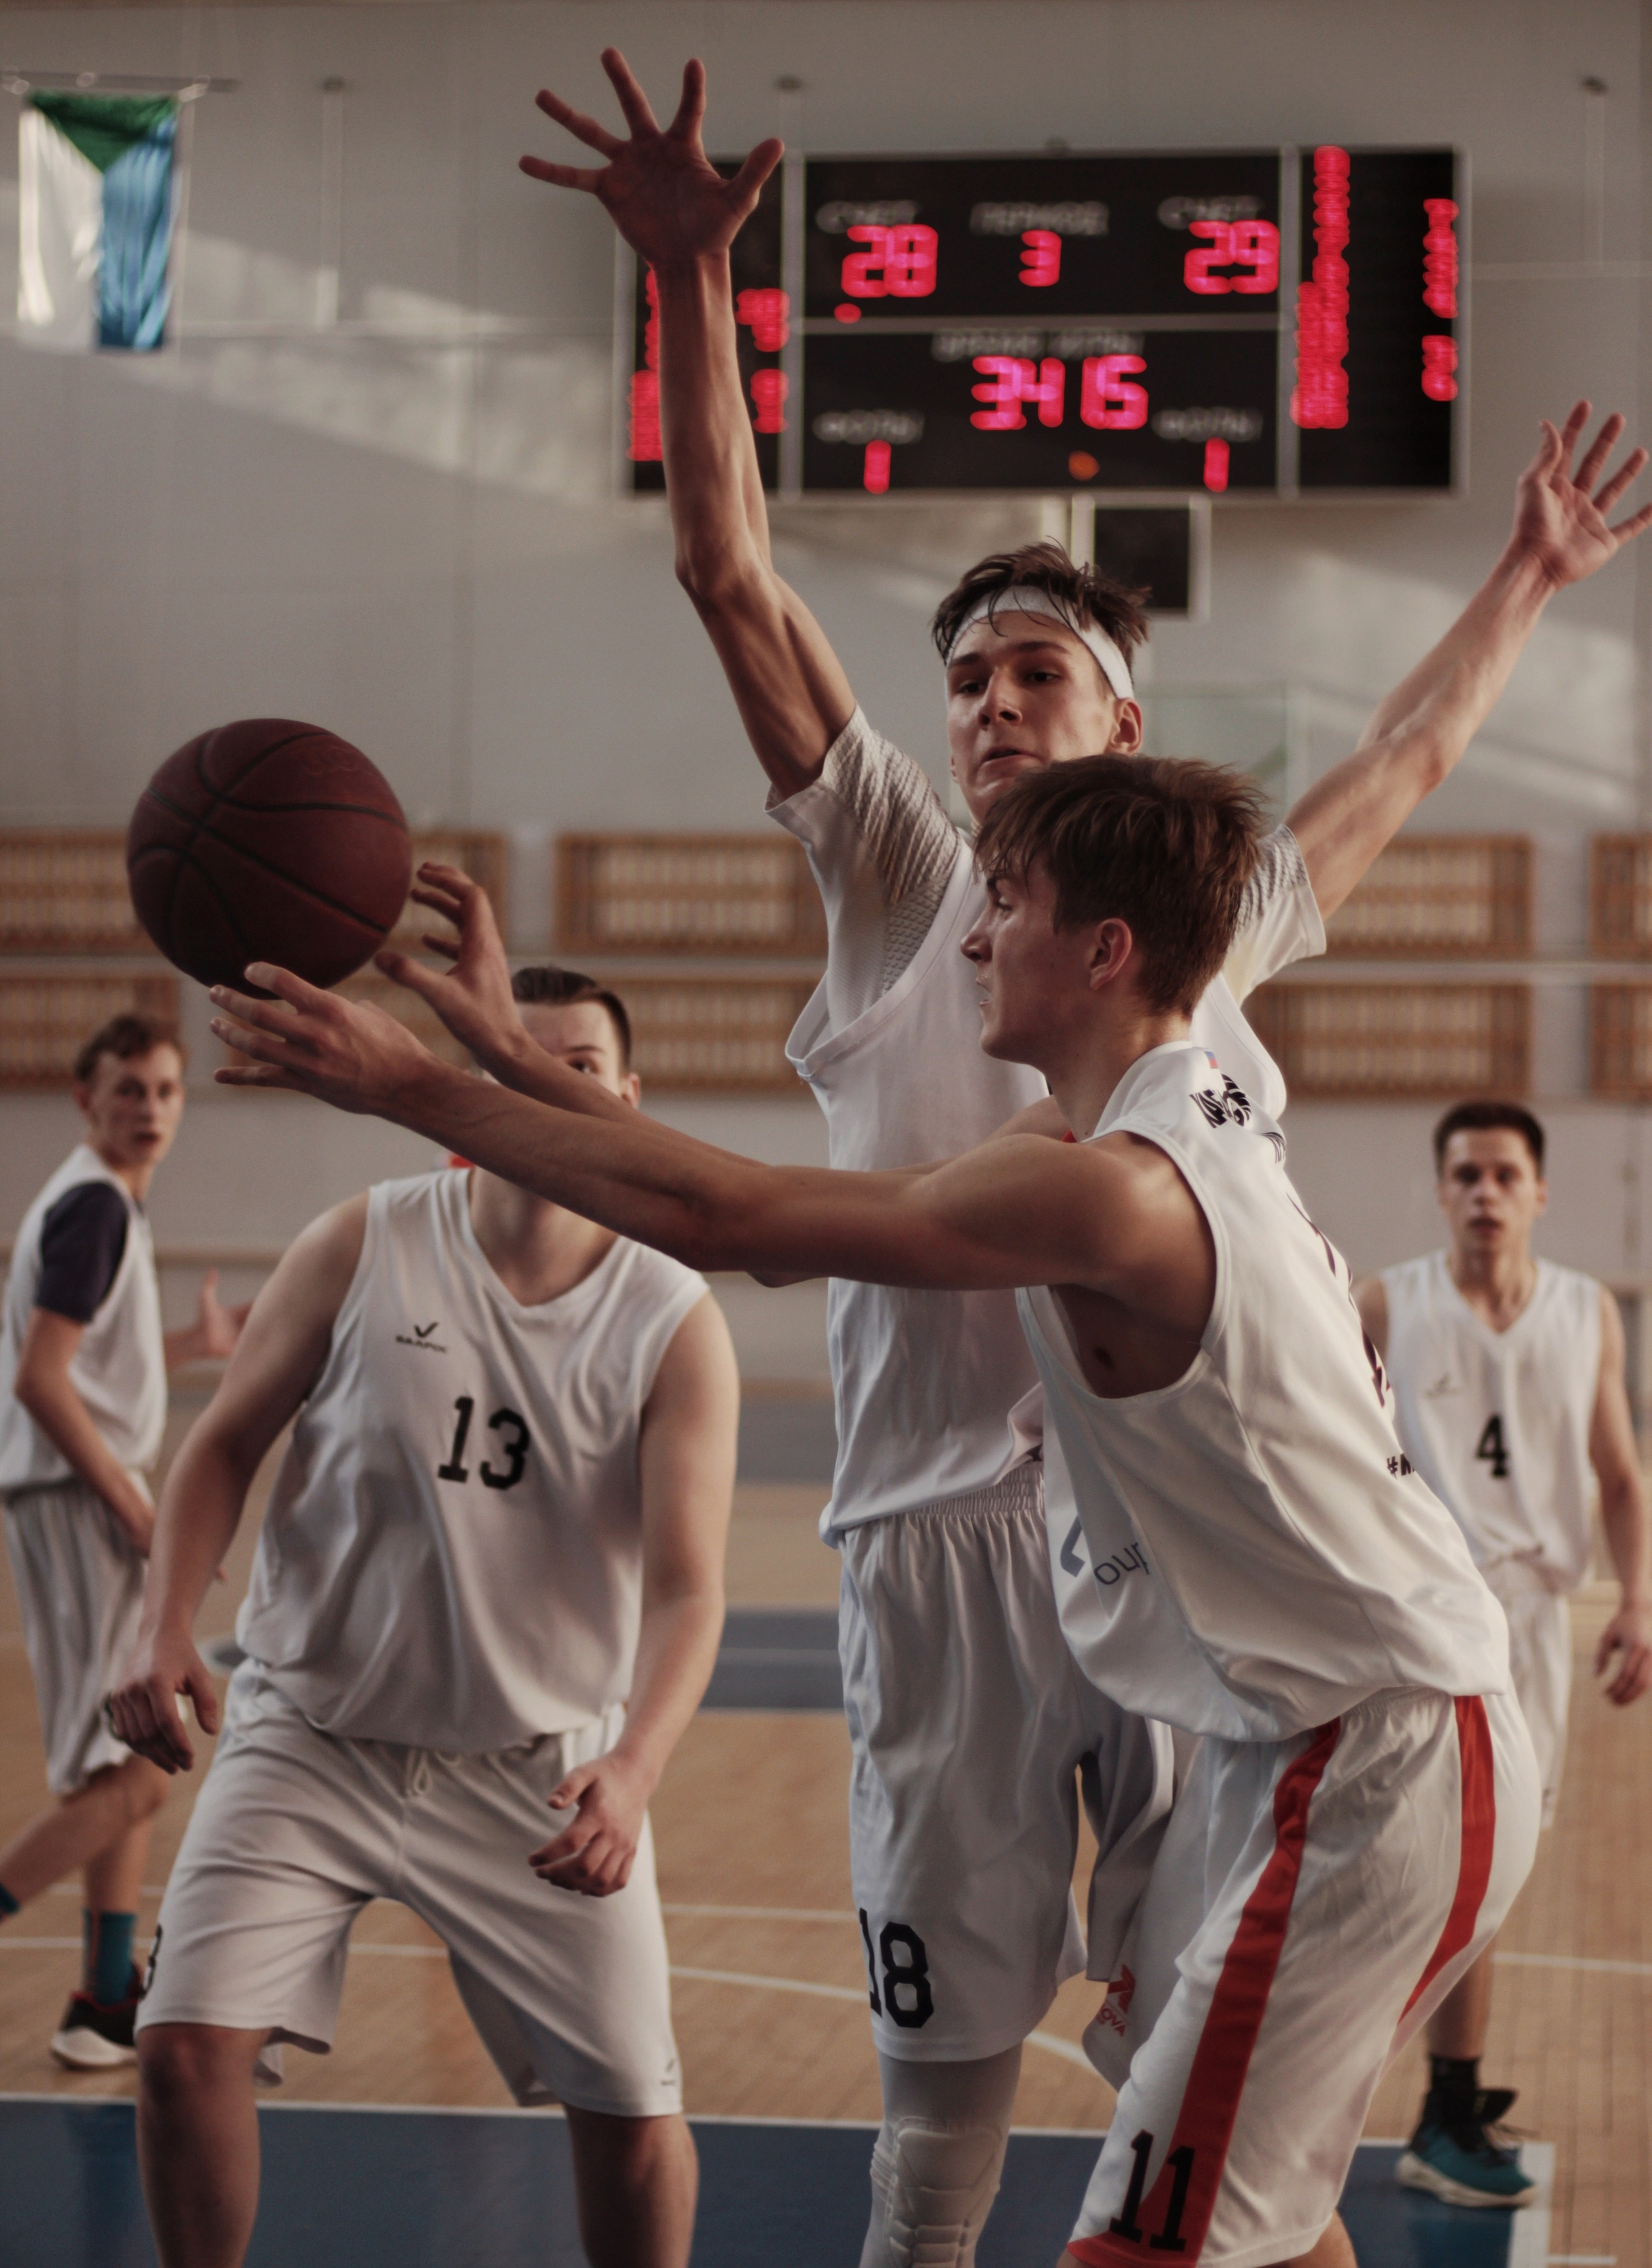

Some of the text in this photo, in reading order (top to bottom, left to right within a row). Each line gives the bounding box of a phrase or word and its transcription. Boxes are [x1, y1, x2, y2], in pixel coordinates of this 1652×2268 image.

[841, 224, 938, 297] 28
[1018, 230, 1062, 286] 3
[1184, 219, 1280, 295] 29
[863, 440, 891, 494] 1
[1203, 437, 1230, 492] 1
[438, 1396, 530, 1490] 13
[1476, 1414, 1509, 1477] 4
[859, 1907, 934, 2029] 18
[1098, 2003, 1125, 2037] OVA
[1109, 2129, 1196, 2251] 11
